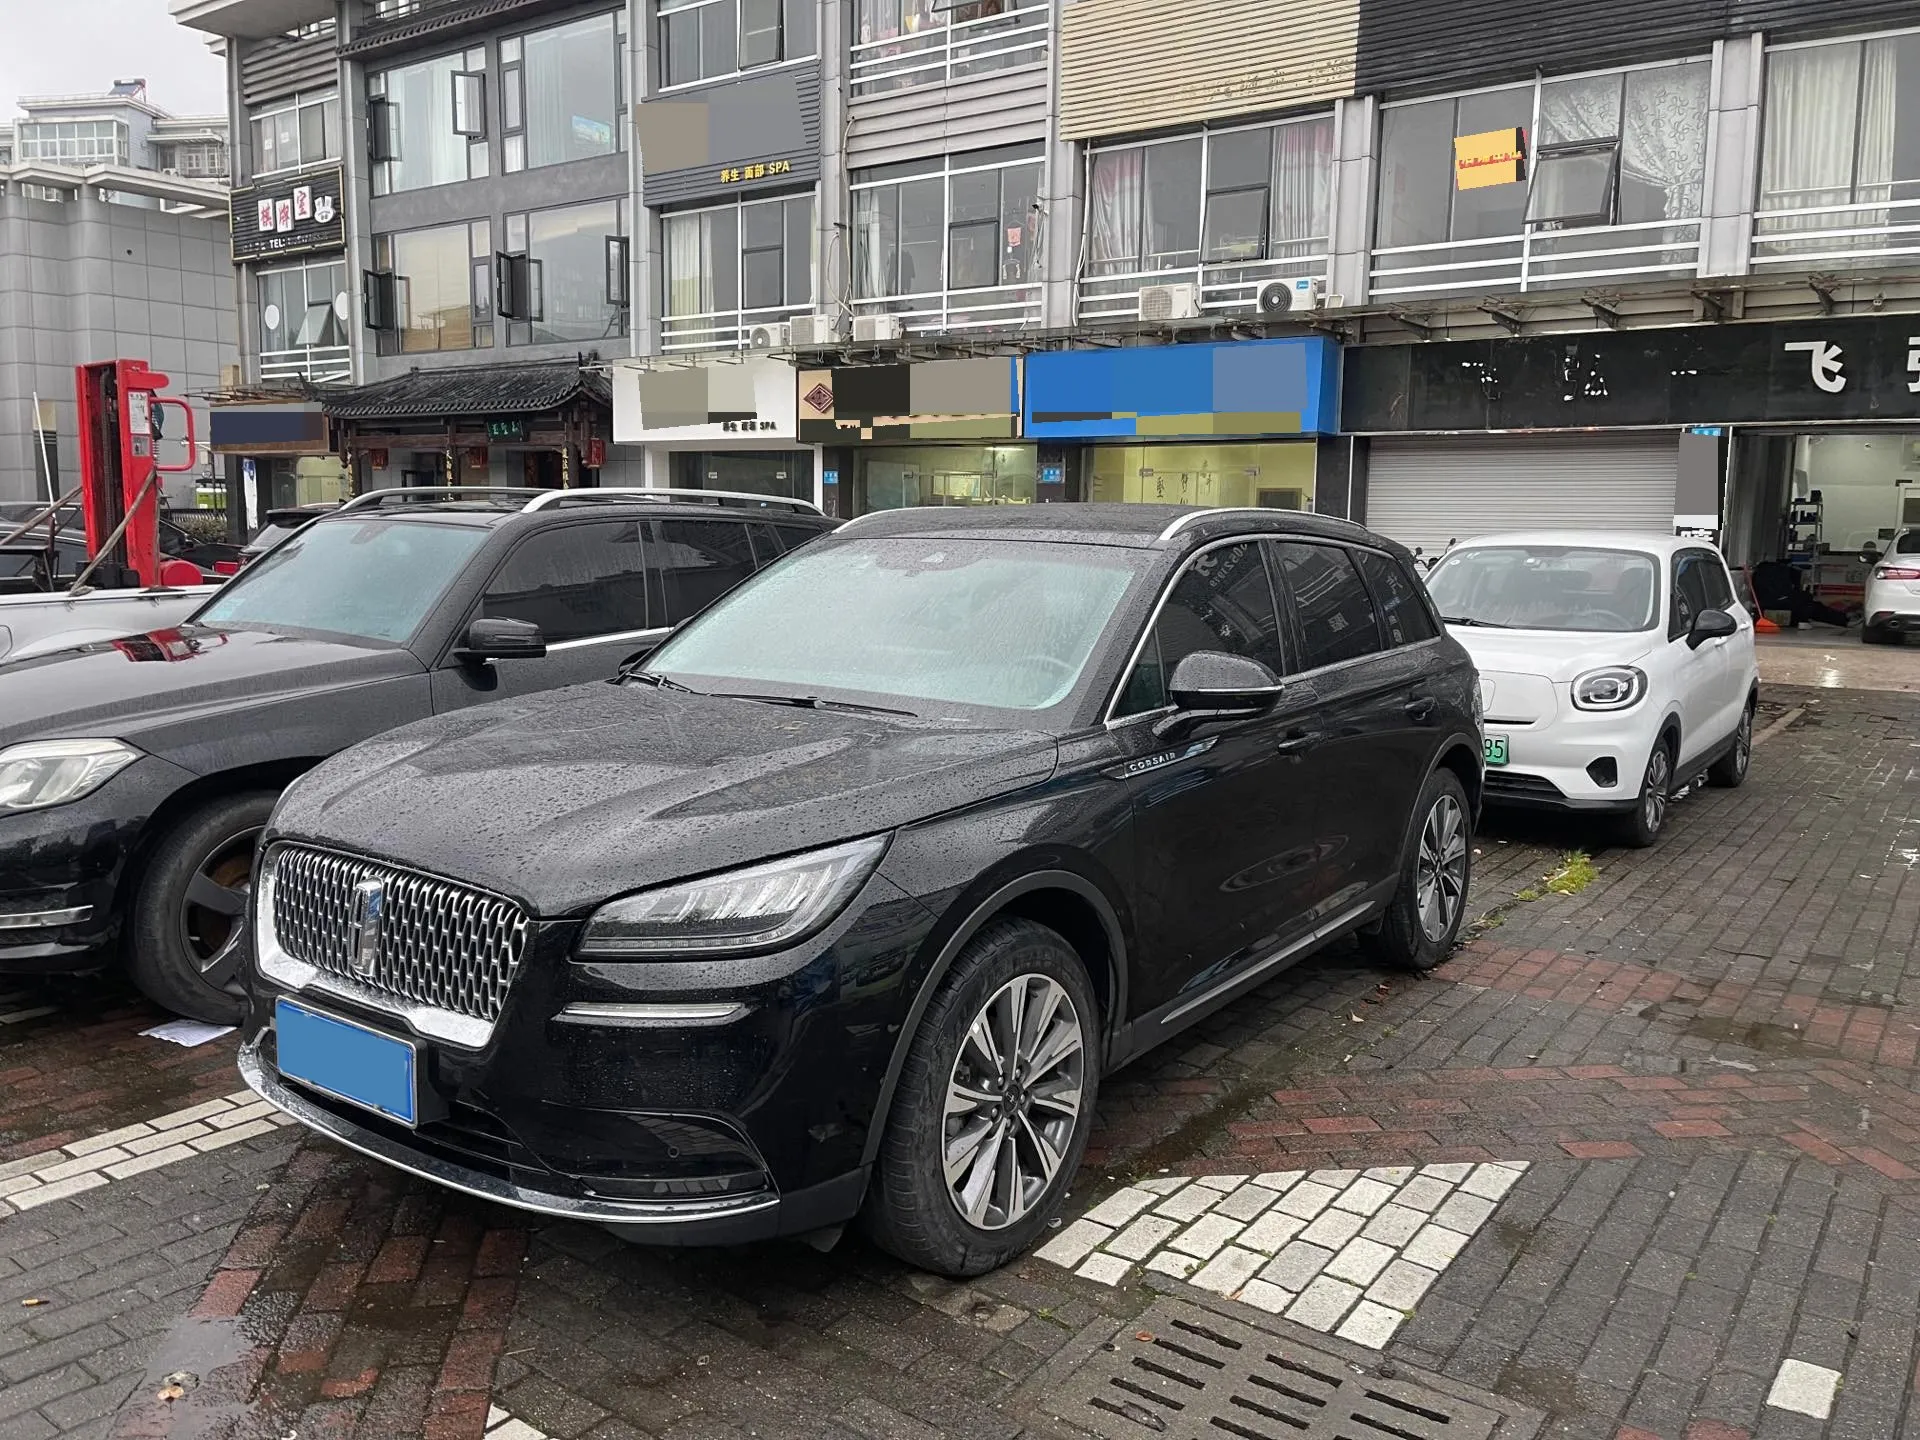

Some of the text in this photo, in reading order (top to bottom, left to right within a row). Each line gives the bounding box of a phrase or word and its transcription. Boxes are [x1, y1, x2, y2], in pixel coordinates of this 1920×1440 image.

[721, 161, 790, 183] 养生 面部 SPA
[759, 421, 777, 431] SPA
[1129, 752, 1176, 772] CORSAIR
